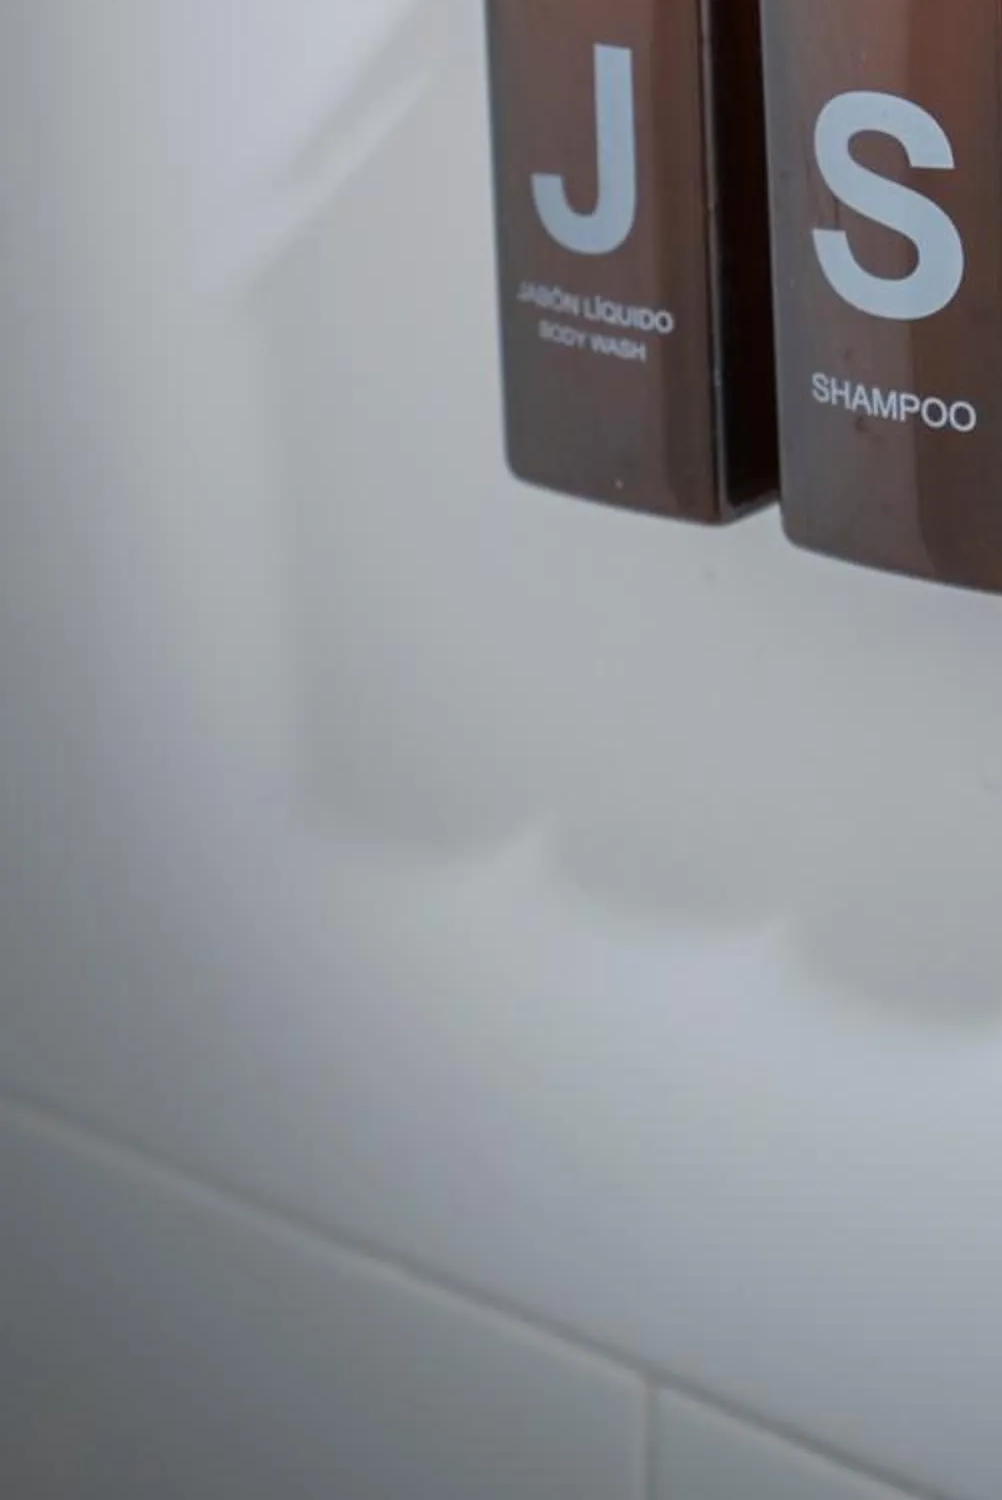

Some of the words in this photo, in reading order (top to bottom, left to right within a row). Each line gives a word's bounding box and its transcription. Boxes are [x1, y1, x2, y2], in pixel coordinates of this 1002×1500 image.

[531, 43, 636, 255] J
[812, 90, 965, 319] S
[538, 320, 588, 349] BODY
[590, 334, 647, 363] WASH
[583, 296, 674, 334] LÍQUIDO
[811, 372, 977, 432] SHAMPOO
